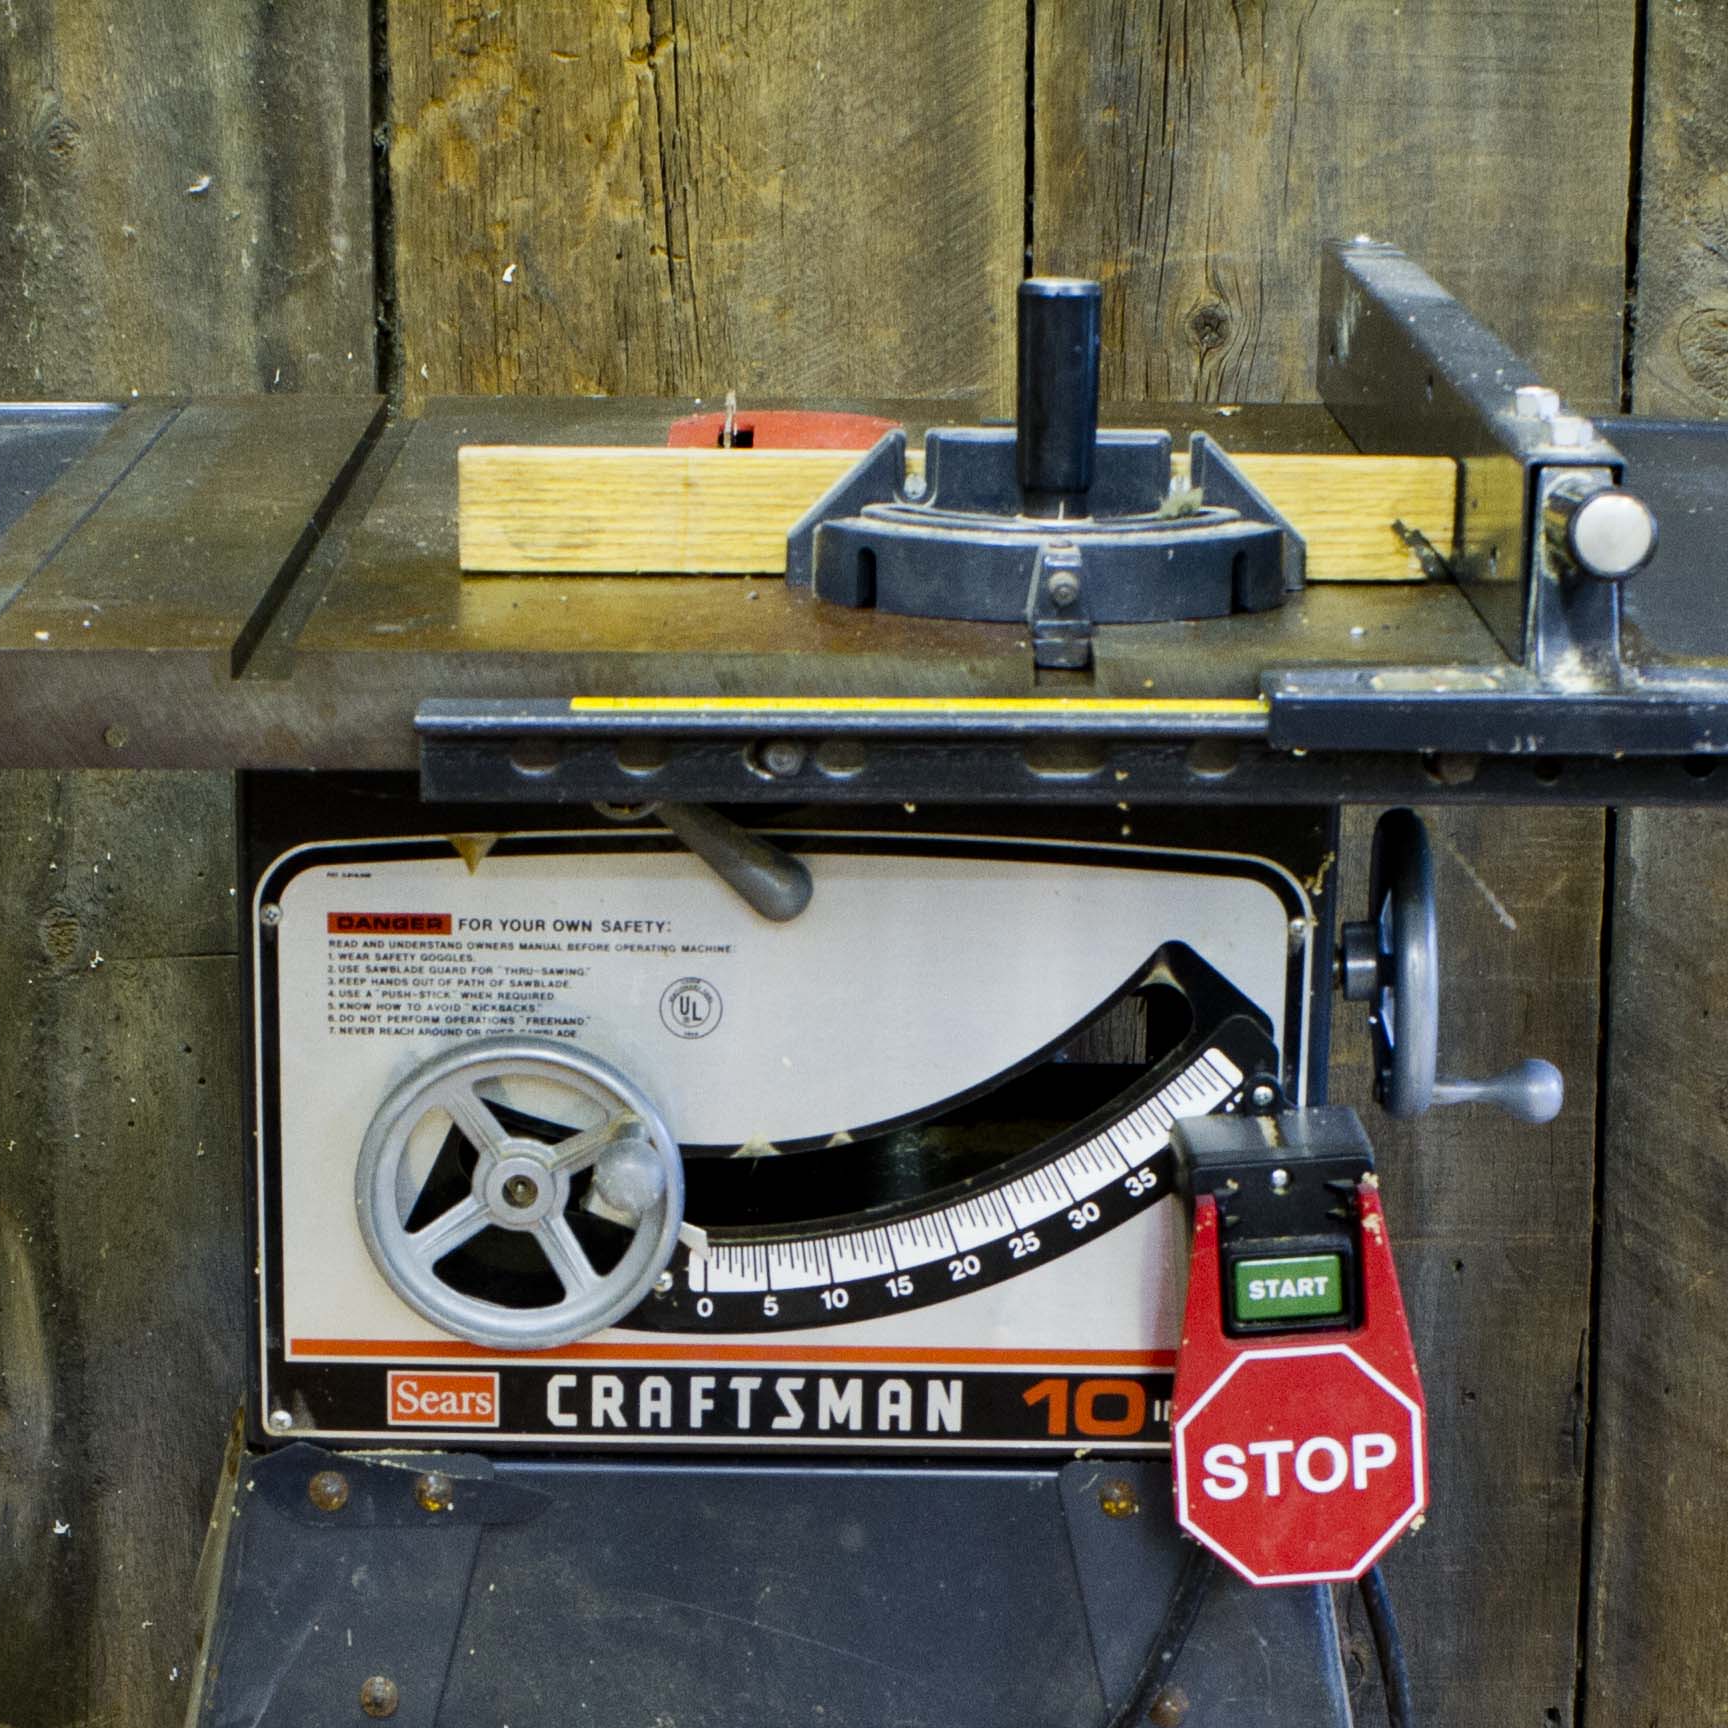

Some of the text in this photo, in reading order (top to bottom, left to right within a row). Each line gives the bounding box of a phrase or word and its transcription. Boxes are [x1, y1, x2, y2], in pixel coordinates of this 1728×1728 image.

[337, 916, 671, 933] DANGER FOR YOUR OWN SAFETY:
[329, 940, 358, 948] READ
[389, 941, 462, 949] UNDERSTAND
[467, 942, 514, 950] OWNERS
[372, 978, 408, 986] HANDS
[339, 990, 361, 998] USE
[445, 1016, 515, 1024] OPERATIONS
[419, 1028, 462, 1036] AROUND
[1125, 1169, 1158, 1197] 35
[1068, 1203, 1101, 1231] 30
[1008, 1233, 1041, 1259] 25
[949, 1255, 980, 1278] 20
[886, 1276, 913, 1297] 15
[1249, 1276, 1329, 1300] START
[697, 1299, 713, 1318] 0
[763, 1297, 778, 1317] 5
[821, 1288, 849, 1310] 10
[397, 1376, 1145, 1436] Sears CRAFTSMAN 10
[1202, 1433, 1397, 1500] STOP
